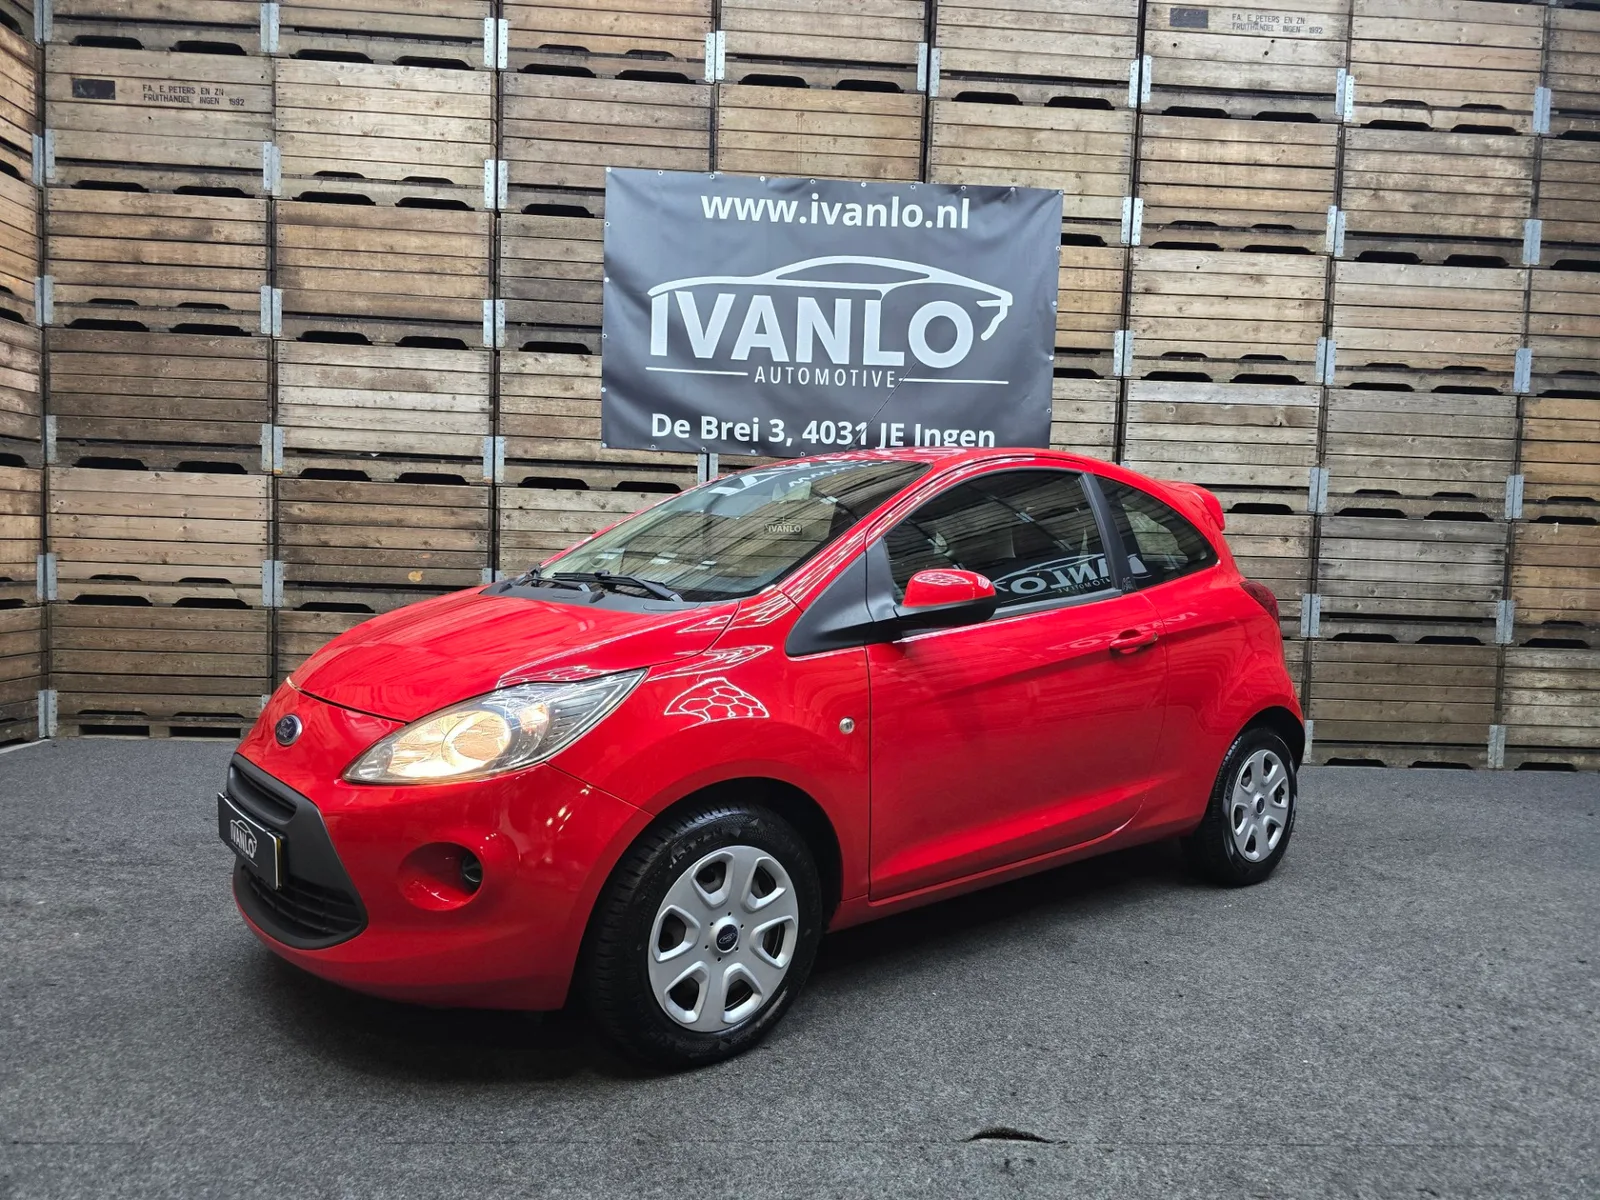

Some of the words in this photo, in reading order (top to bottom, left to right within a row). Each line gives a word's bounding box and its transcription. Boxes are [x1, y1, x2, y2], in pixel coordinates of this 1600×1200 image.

[1255, 14, 1280, 24] PETERS
[1284, 16, 1293, 24] EN
[1282, 25, 1301, 33] INGEN
[168, 85, 196, 95] PETERS
[200, 87, 210, 95] EN
[143, 93, 191, 104] FRUITHANDEL
[199, 96, 220, 105] INGEN
[700, 192, 970, 229] www.ivanlo.nl
[650, 290, 974, 369] IVANLO
[754, 366, 896, 388] AUTOMOTIVE
[651, 413, 690, 438] De
[700, 416, 759, 442] Brei
[768, 419, 793, 447] 3,
[802, 420, 868, 446] 4031
[875, 423, 904, 450] JE
[914, 424, 995, 448] Ingen
[768, 525, 802, 533] IVANLO
[230, 821, 255, 858] IVANLO
